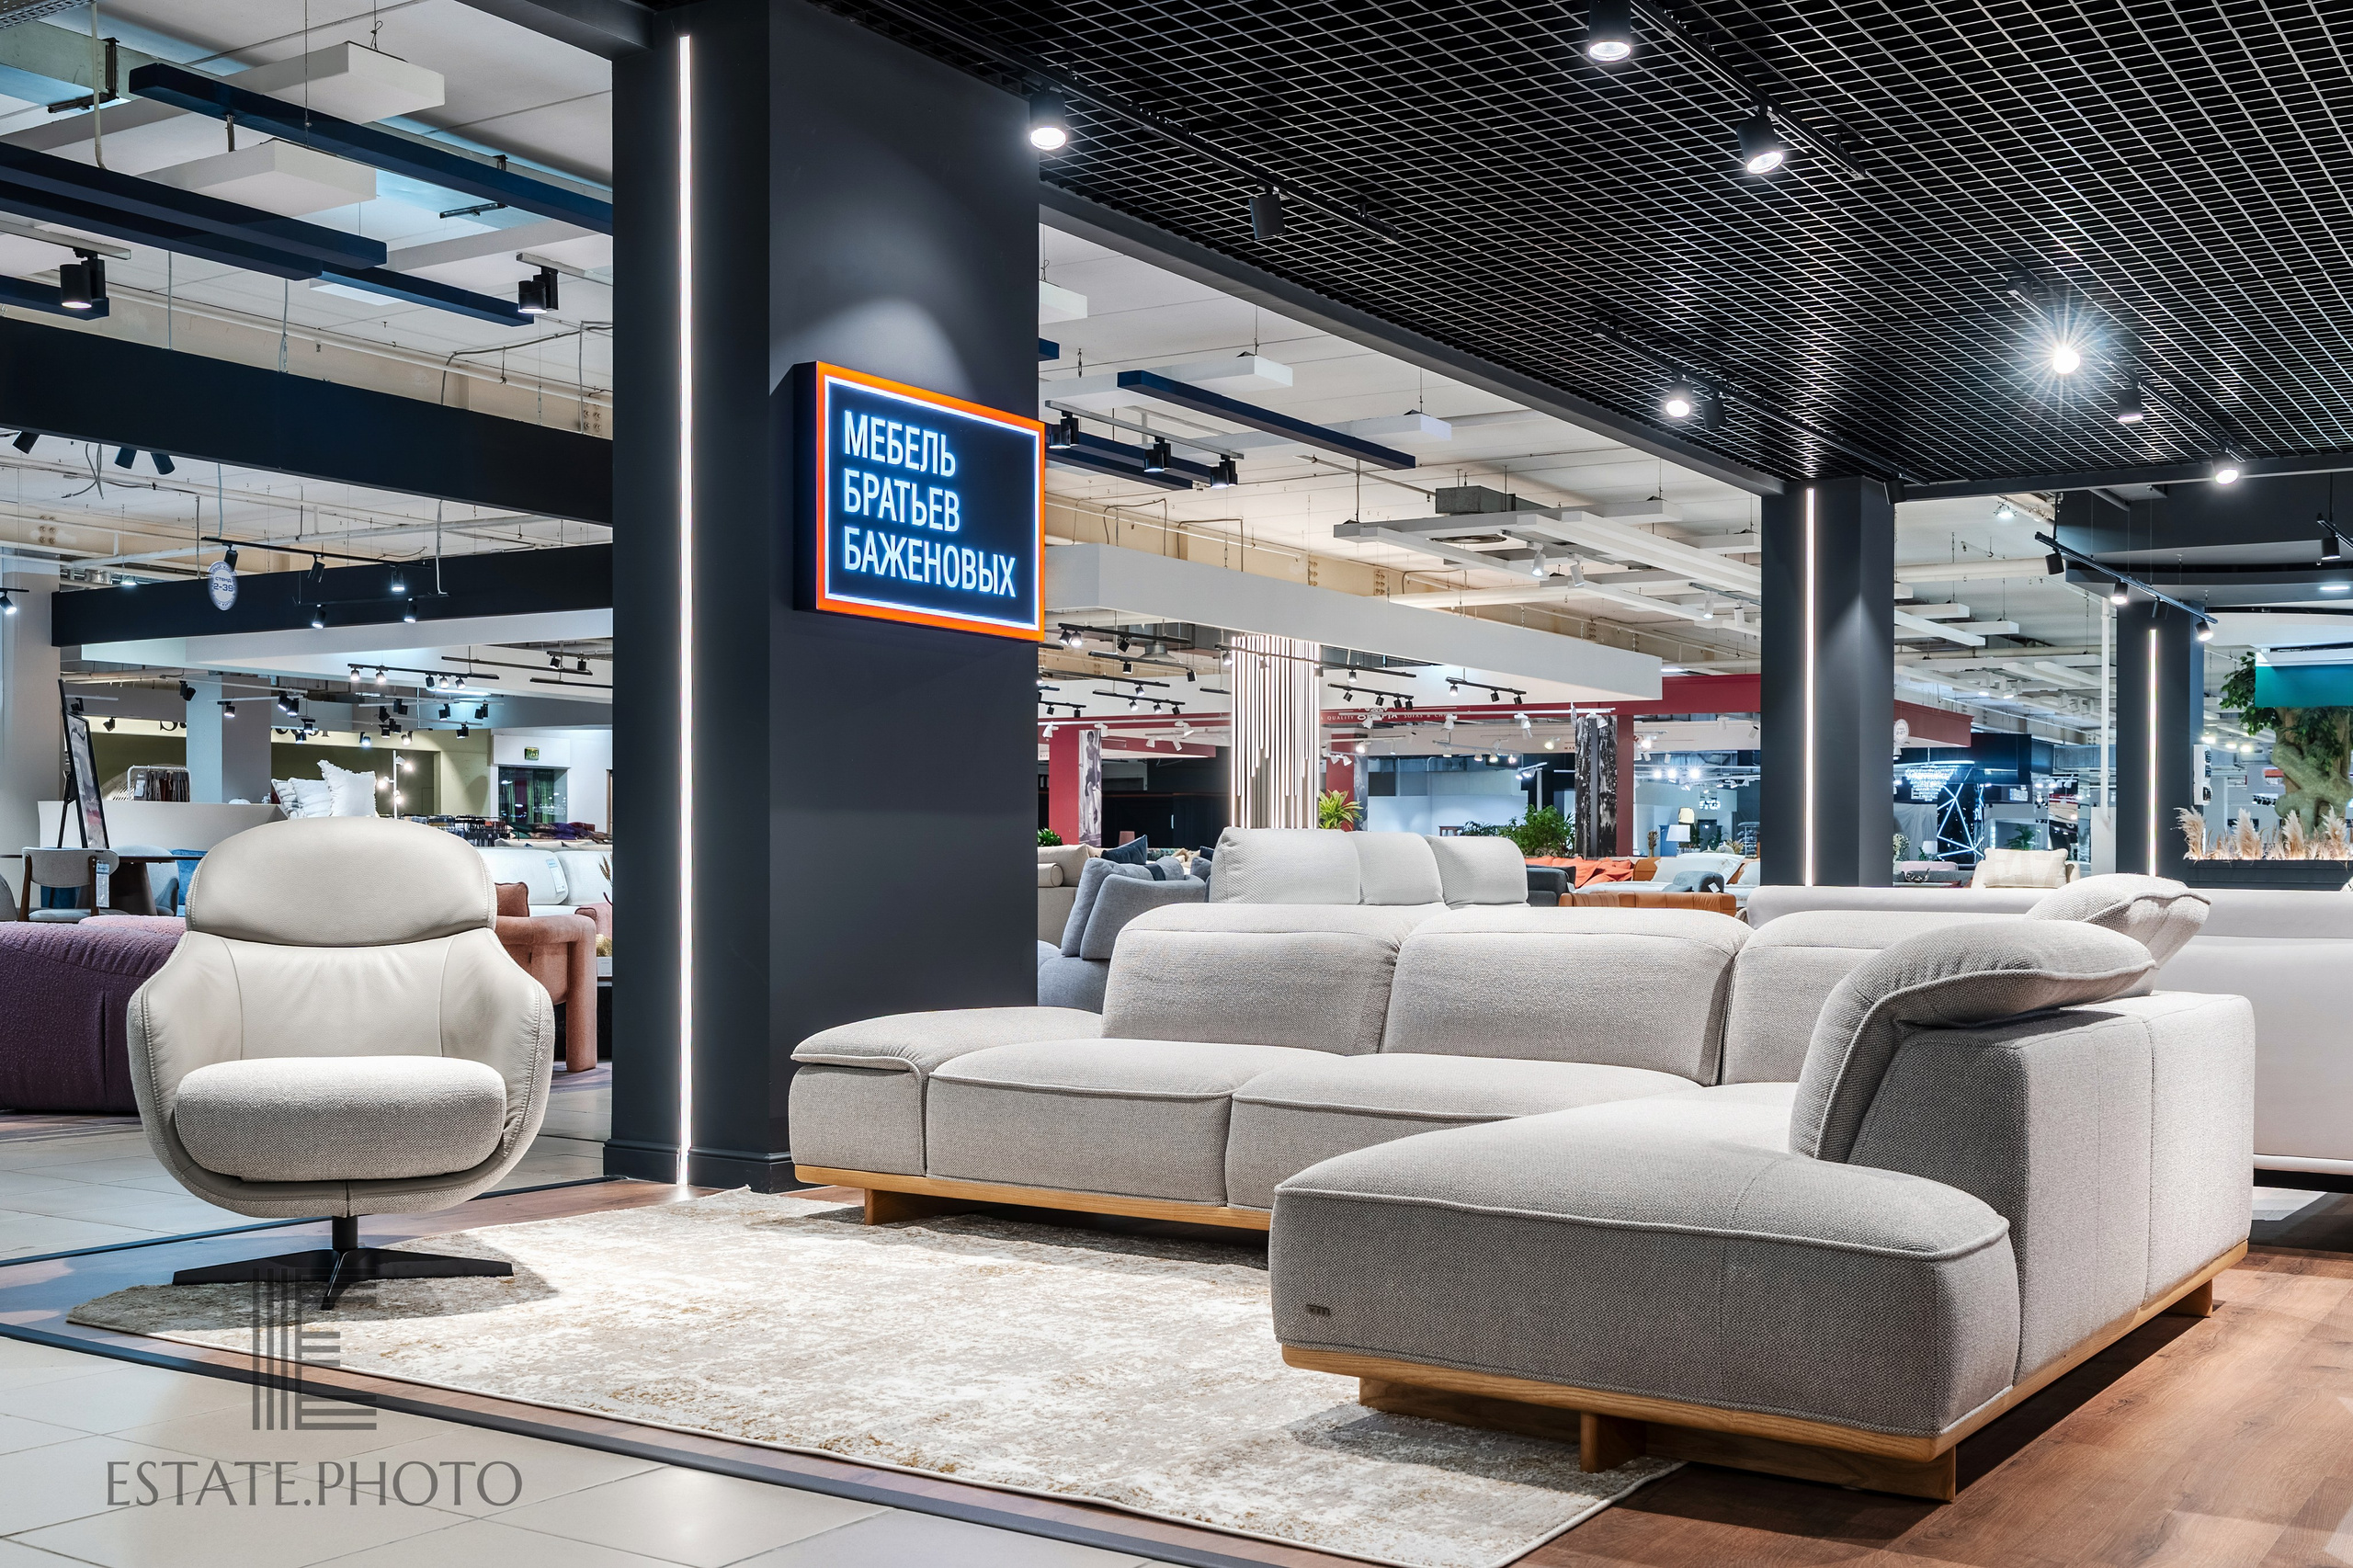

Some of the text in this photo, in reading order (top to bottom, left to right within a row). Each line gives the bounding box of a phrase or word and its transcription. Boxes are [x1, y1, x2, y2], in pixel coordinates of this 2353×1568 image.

[844, 409, 957, 478] МЕБЕЛЬ
[844, 467, 961, 533] БРАТЬЕВ
[213, 583, 233, 592] 2-39
[844, 526, 1017, 598] БАЖЕНОВЫХ
